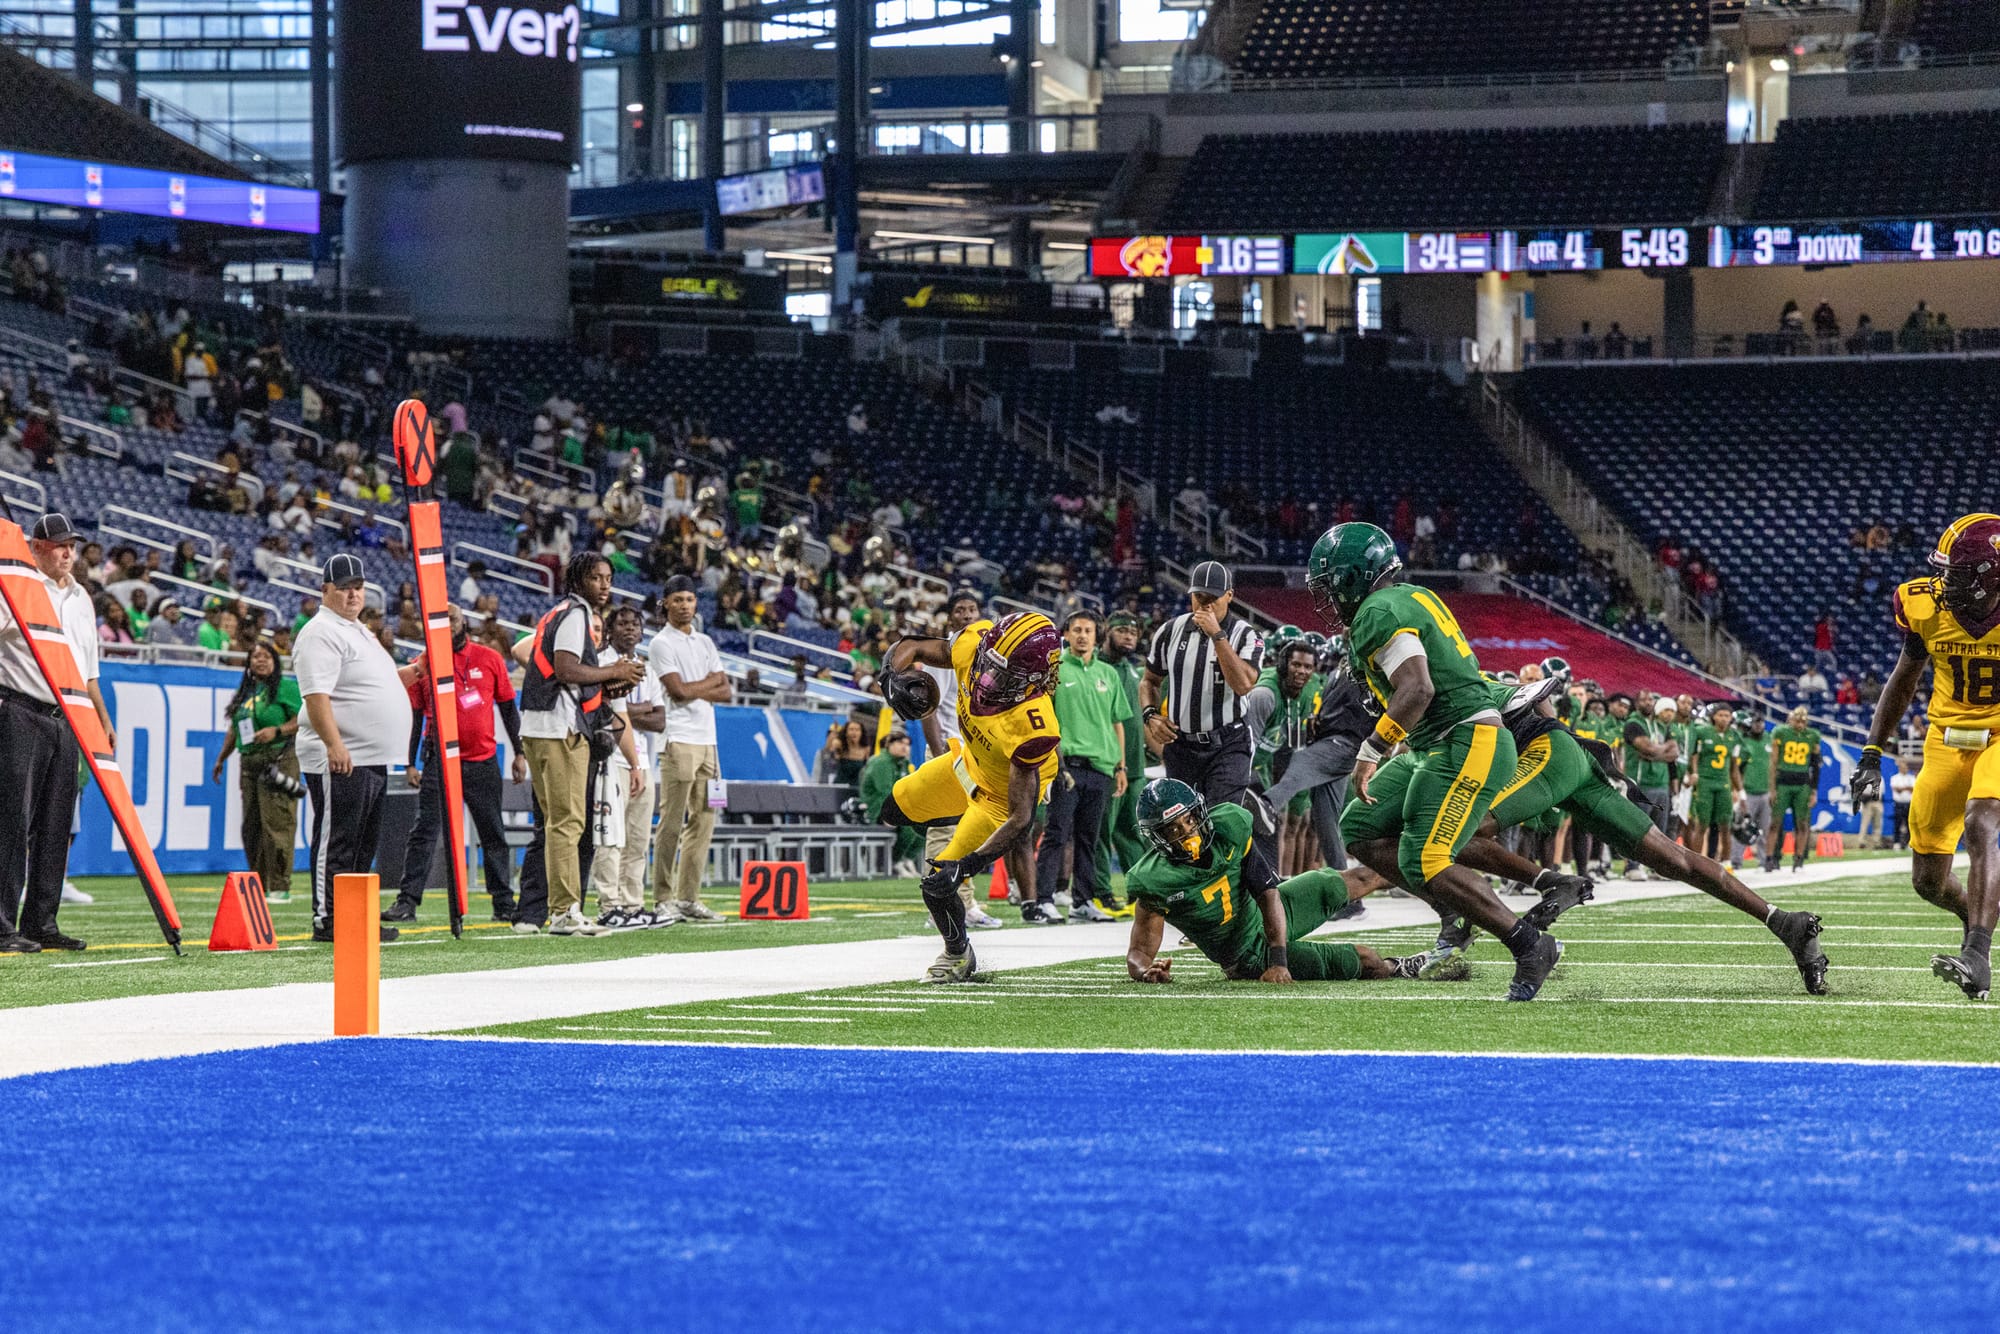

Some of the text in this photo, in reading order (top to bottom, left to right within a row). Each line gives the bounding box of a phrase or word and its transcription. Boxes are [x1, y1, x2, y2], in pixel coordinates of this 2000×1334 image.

[422, 0, 579, 62] Ever?
[1216, 236, 1250, 273] 16
[1418, 233, 1457, 271] 34
[1527, 231, 1587, 269] QTR 4
[1621, 228, 1689, 267] 5:43
[1797, 233, 1863, 261] DOWN
[1911, 221, 1936, 260] 4
[1953, 230, 1984, 257] TO
[1935, 641, 2000, 656] CENTRAL ST
[1947, 655, 2000, 706] 18
[971, 725, 993, 752] STATE
[1026, 708, 1046, 731] 6
[1711, 744, 1728, 769] 3
[1783, 741, 1810, 766] 88
[1432, 775, 1482, 847] THOROBREDS
[239, 875, 273, 945] 10
[746, 866, 798, 917] 20
[1201, 875, 1233, 926] 7
